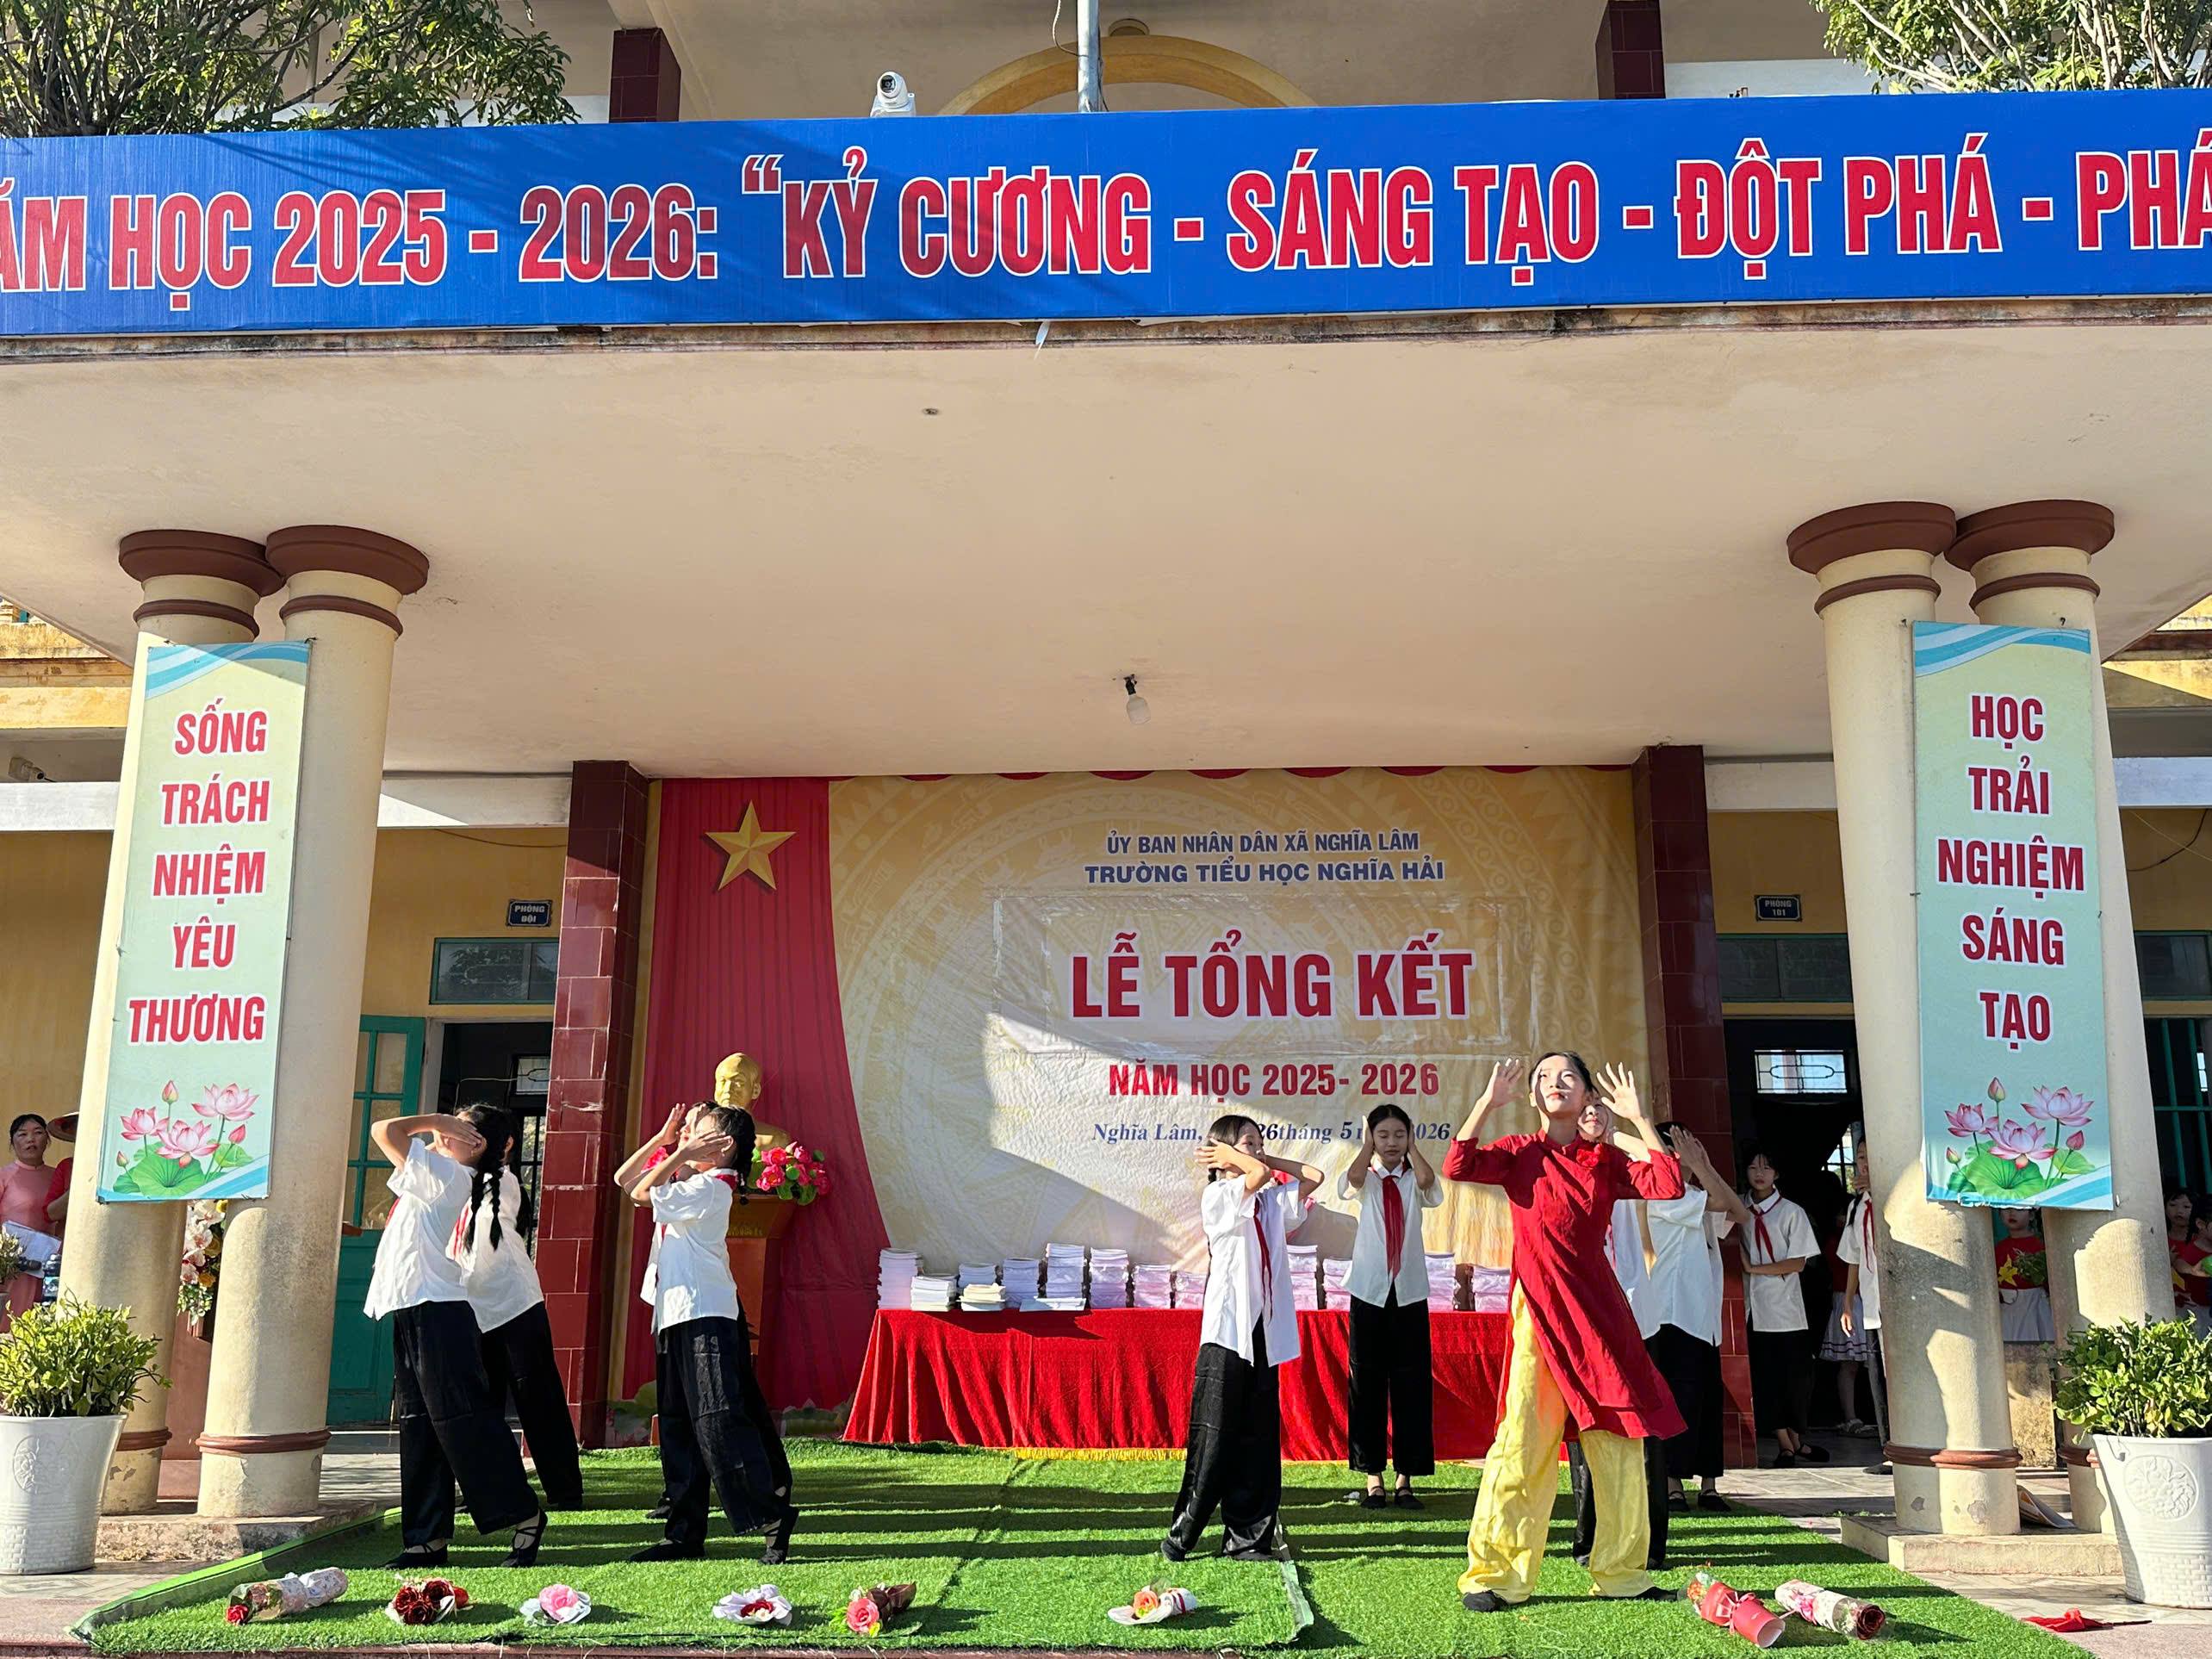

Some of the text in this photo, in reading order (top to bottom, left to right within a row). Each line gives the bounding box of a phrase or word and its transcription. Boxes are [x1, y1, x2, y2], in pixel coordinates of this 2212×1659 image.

[109, 190, 252, 312] HỌC
[271, 189, 448, 288] 2025
[469, 229, 499, 254] -
[519, 183, 719, 283] 2026:
[898, 165, 1152, 278] CƯƠNG
[1174, 216, 1205, 242] -
[1227, 148, 1433, 273] SÁNG
[1454, 160, 1600, 287] TẠO
[1622, 205, 1655, 230] -
[1674, 137, 1823, 281] ĐỘT
[1843, 132, 2003, 256] PHÁ
[2022, 196, 2054, 221] -
[174, 697, 269, 755] SỐNG
[1971, 694, 2045, 749] HỌC
[161, 773, 270, 826] TRÁCH
[1967, 755, 2050, 816] TRẢI
[1107, 829, 1420, 854] ỦY BAN NHÂN DÂN XÃ NGHĨA LÂM
[1937, 835, 2085, 899] NGHIỆM
[152, 843, 267, 905] NHIỆM
[1084, 854, 1444, 886] TRƯỜNG TIỂU HỌC NGHĨA HẢI
[171, 916, 237, 970] YÊU
[1961, 907, 2065, 966] SÁNG
[1072, 929, 1473, 1018] LỄ TỔNG KẾT
[128, 993, 267, 1044] THƯƠNG
[1979, 991, 2052, 1051] TẠO
[1109, 1058, 1439, 1103] NĂM HỌC 2025- 2026
[1092, 1123, 1147, 1144] Nghĩa
[1154, 1123, 1202, 1143] Lâm,
[1340, 1122, 1352, 1140] 5
[1414, 1122, 1451, 1140] 026
